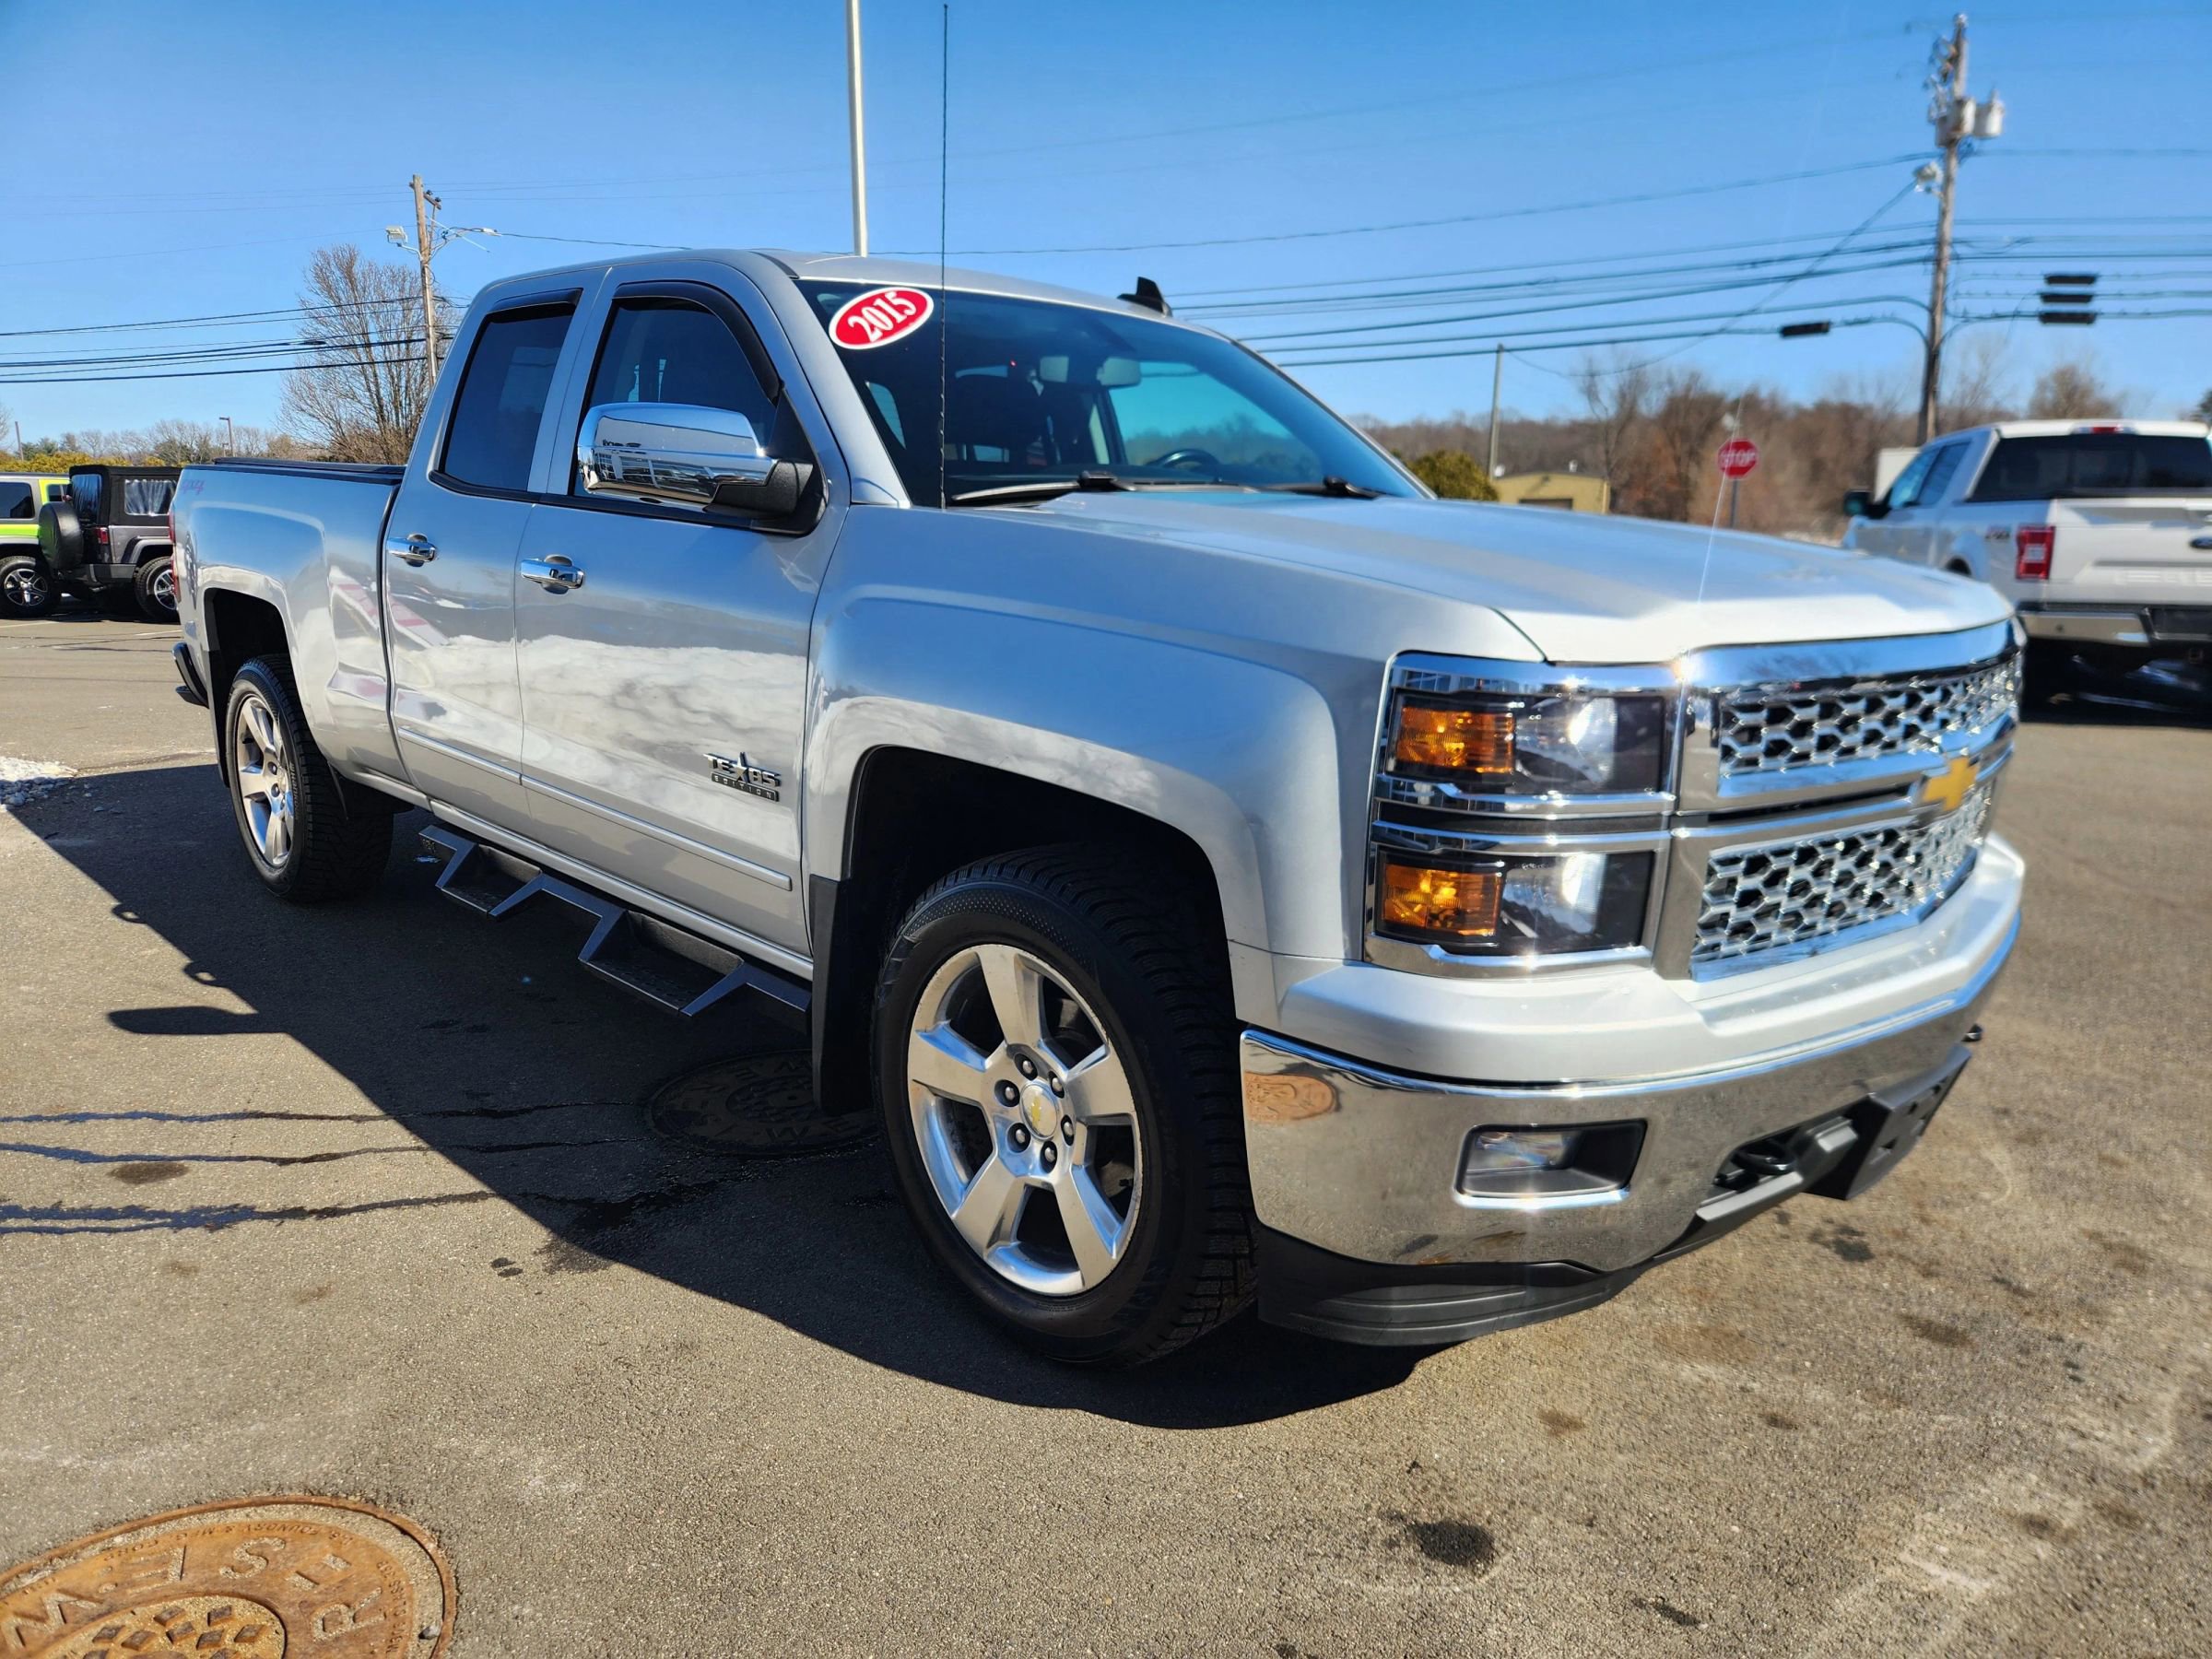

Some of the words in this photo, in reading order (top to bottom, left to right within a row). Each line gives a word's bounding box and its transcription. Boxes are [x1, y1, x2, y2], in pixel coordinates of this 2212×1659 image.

[847, 290, 917, 343] 2015
[1719, 448, 1756, 467] STOP
[702, 751, 782, 788] TEXAS
[712, 774, 773, 800] EDITION
[244, 1523, 321, 1537] FOUNDRY
